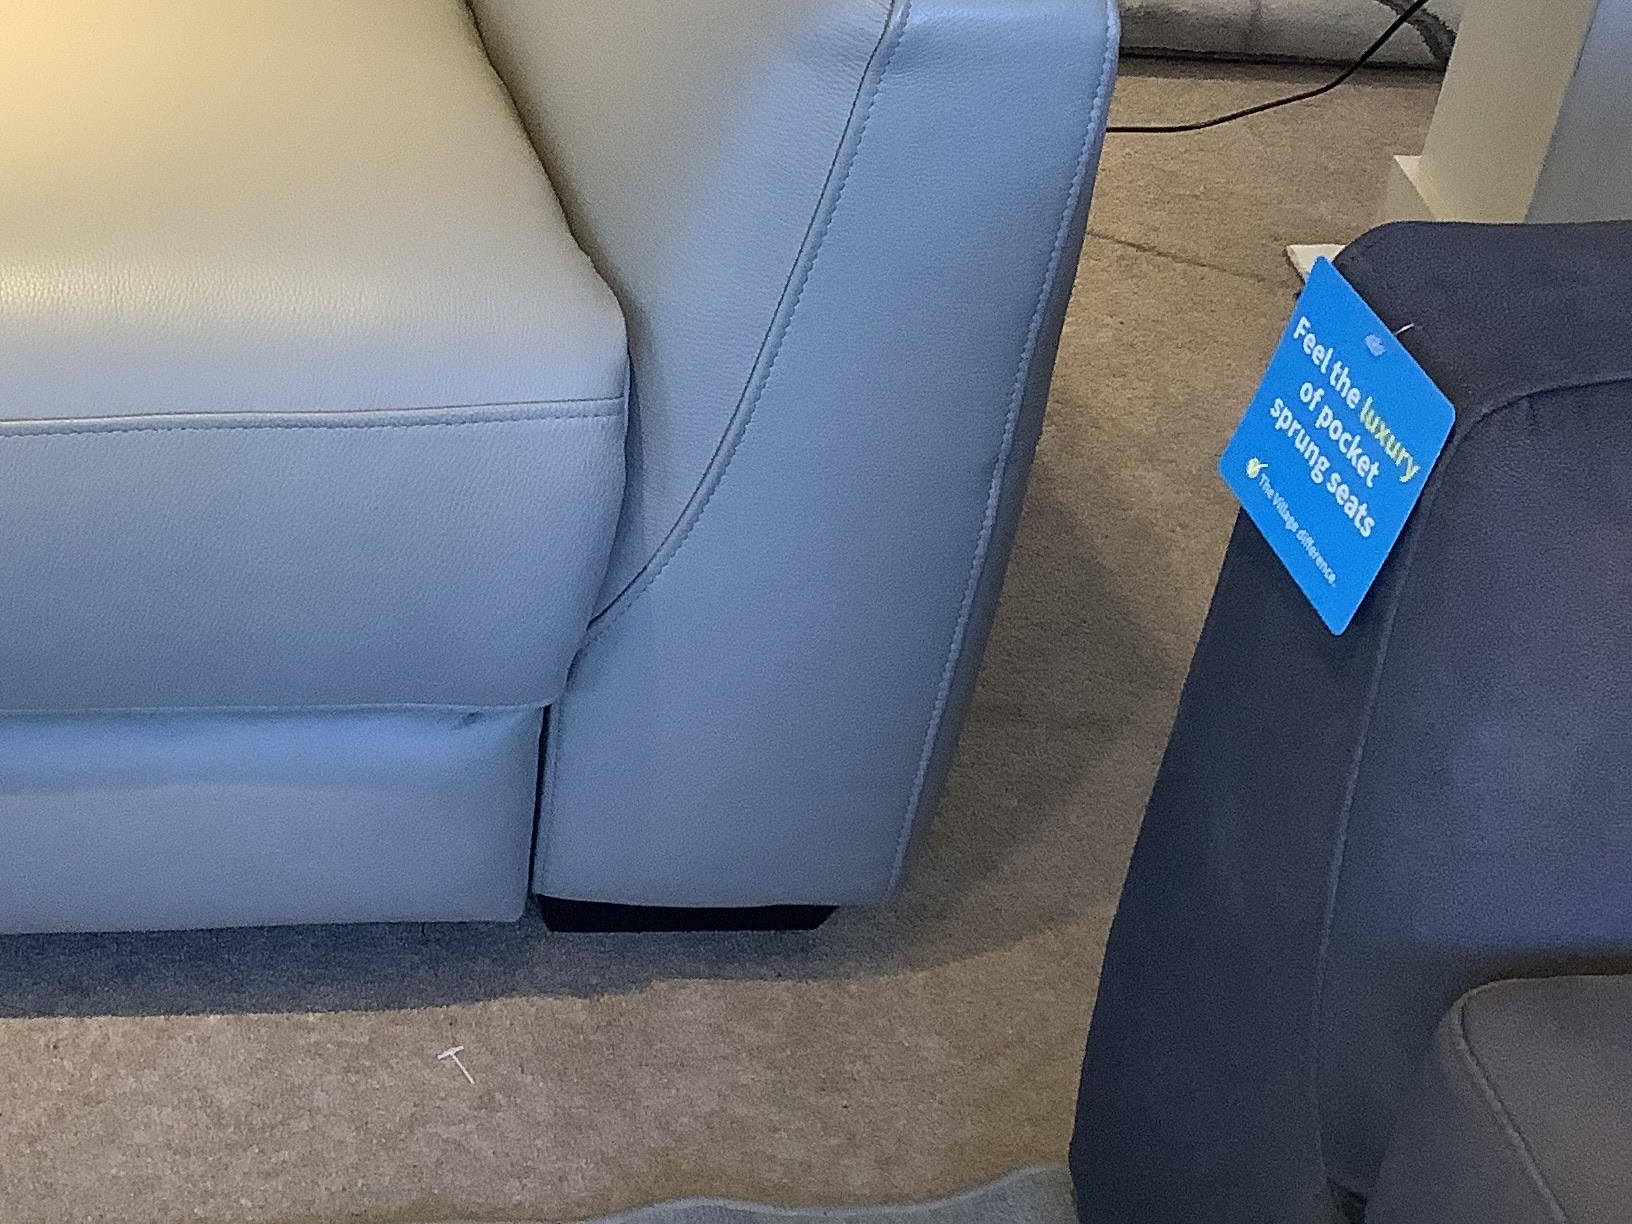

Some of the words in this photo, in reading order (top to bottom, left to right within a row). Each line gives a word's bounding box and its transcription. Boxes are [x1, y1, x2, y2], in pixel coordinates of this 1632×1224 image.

[1292, 316, 1332, 376] Feel
[1328, 359, 1362, 410] the
[1360, 396, 1421, 484] luxury
[1299, 381, 1325, 413] of
[1314, 407, 1380, 489] pocket
[1259, 473, 1275, 499] The
[1269, 397, 1330, 484] sprung
[1325, 471, 1376, 538] seats
